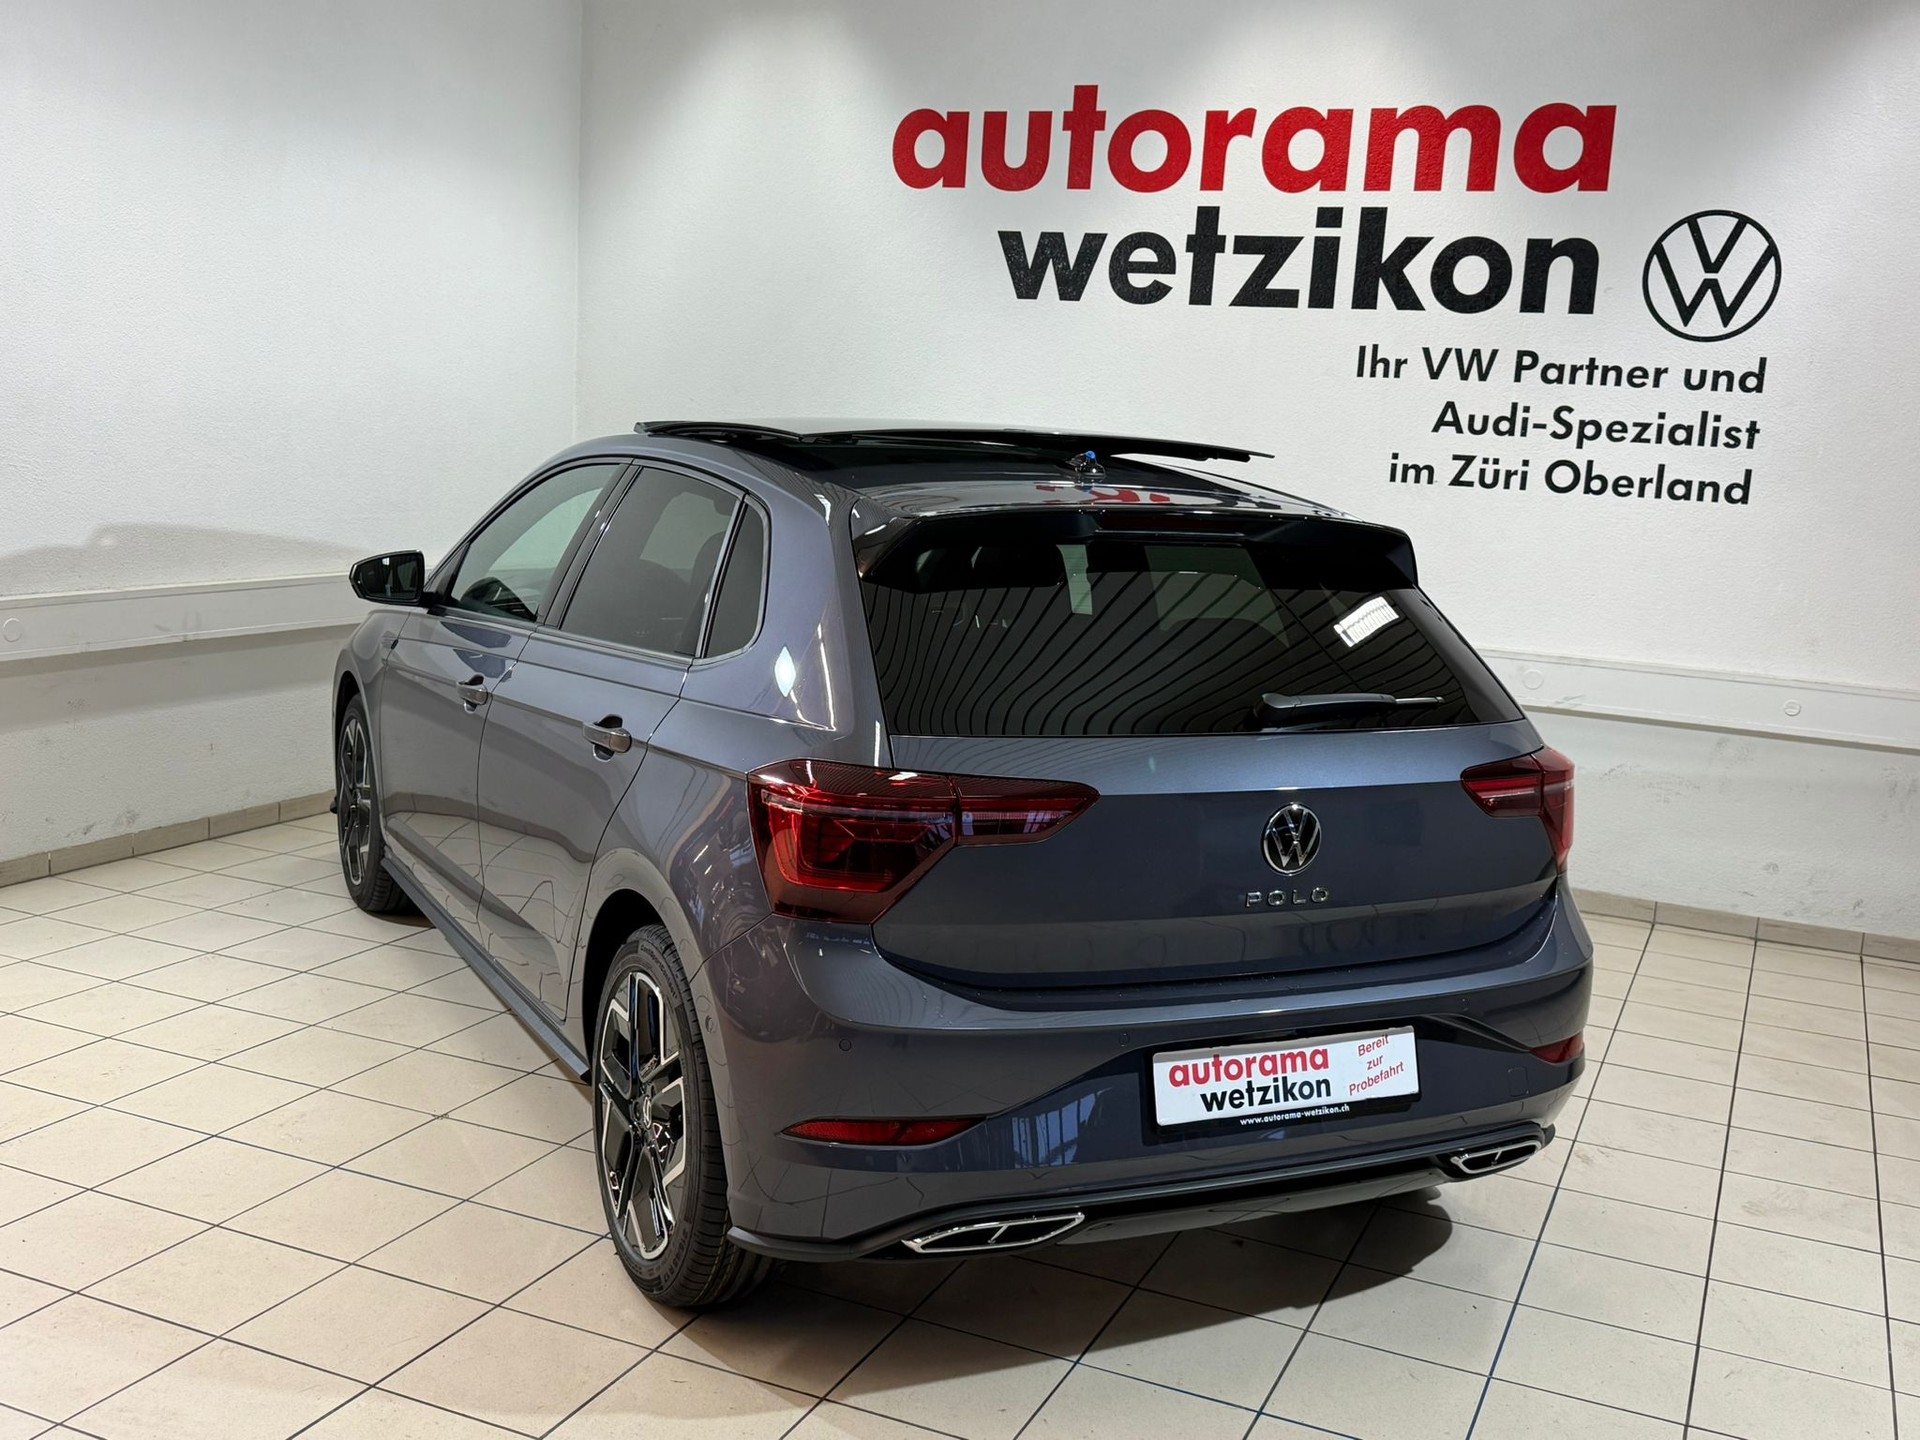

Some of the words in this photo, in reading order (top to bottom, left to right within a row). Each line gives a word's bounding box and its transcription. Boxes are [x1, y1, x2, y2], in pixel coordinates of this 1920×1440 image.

[893, 85, 1616, 193] autorama
[998, 206, 1600, 314] wetzikon
[1356, 344, 1408, 379] Ihr
[1422, 347, 1498, 382] VW
[1514, 350, 1669, 389] Partner
[1683, 357, 1768, 394] und
[1431, 401, 1761, 450] Audi-Spezialist
[1389, 453, 1435, 485] im
[1449, 455, 1530, 491] Züri
[1544, 460, 1753, 505] Oberland
[1246, 887, 1329, 908] POLO
[1357, 1034, 1389, 1057] Bereit
[1366, 1054, 1384, 1071] zur
[1168, 1048, 1330, 1088] autorama
[1348, 1061, 1405, 1097] Probefahrt
[1200, 1075, 1332, 1112] wetzikon
[1239, 1103, 1351, 1126] www.autorama-wetzikon.ch
